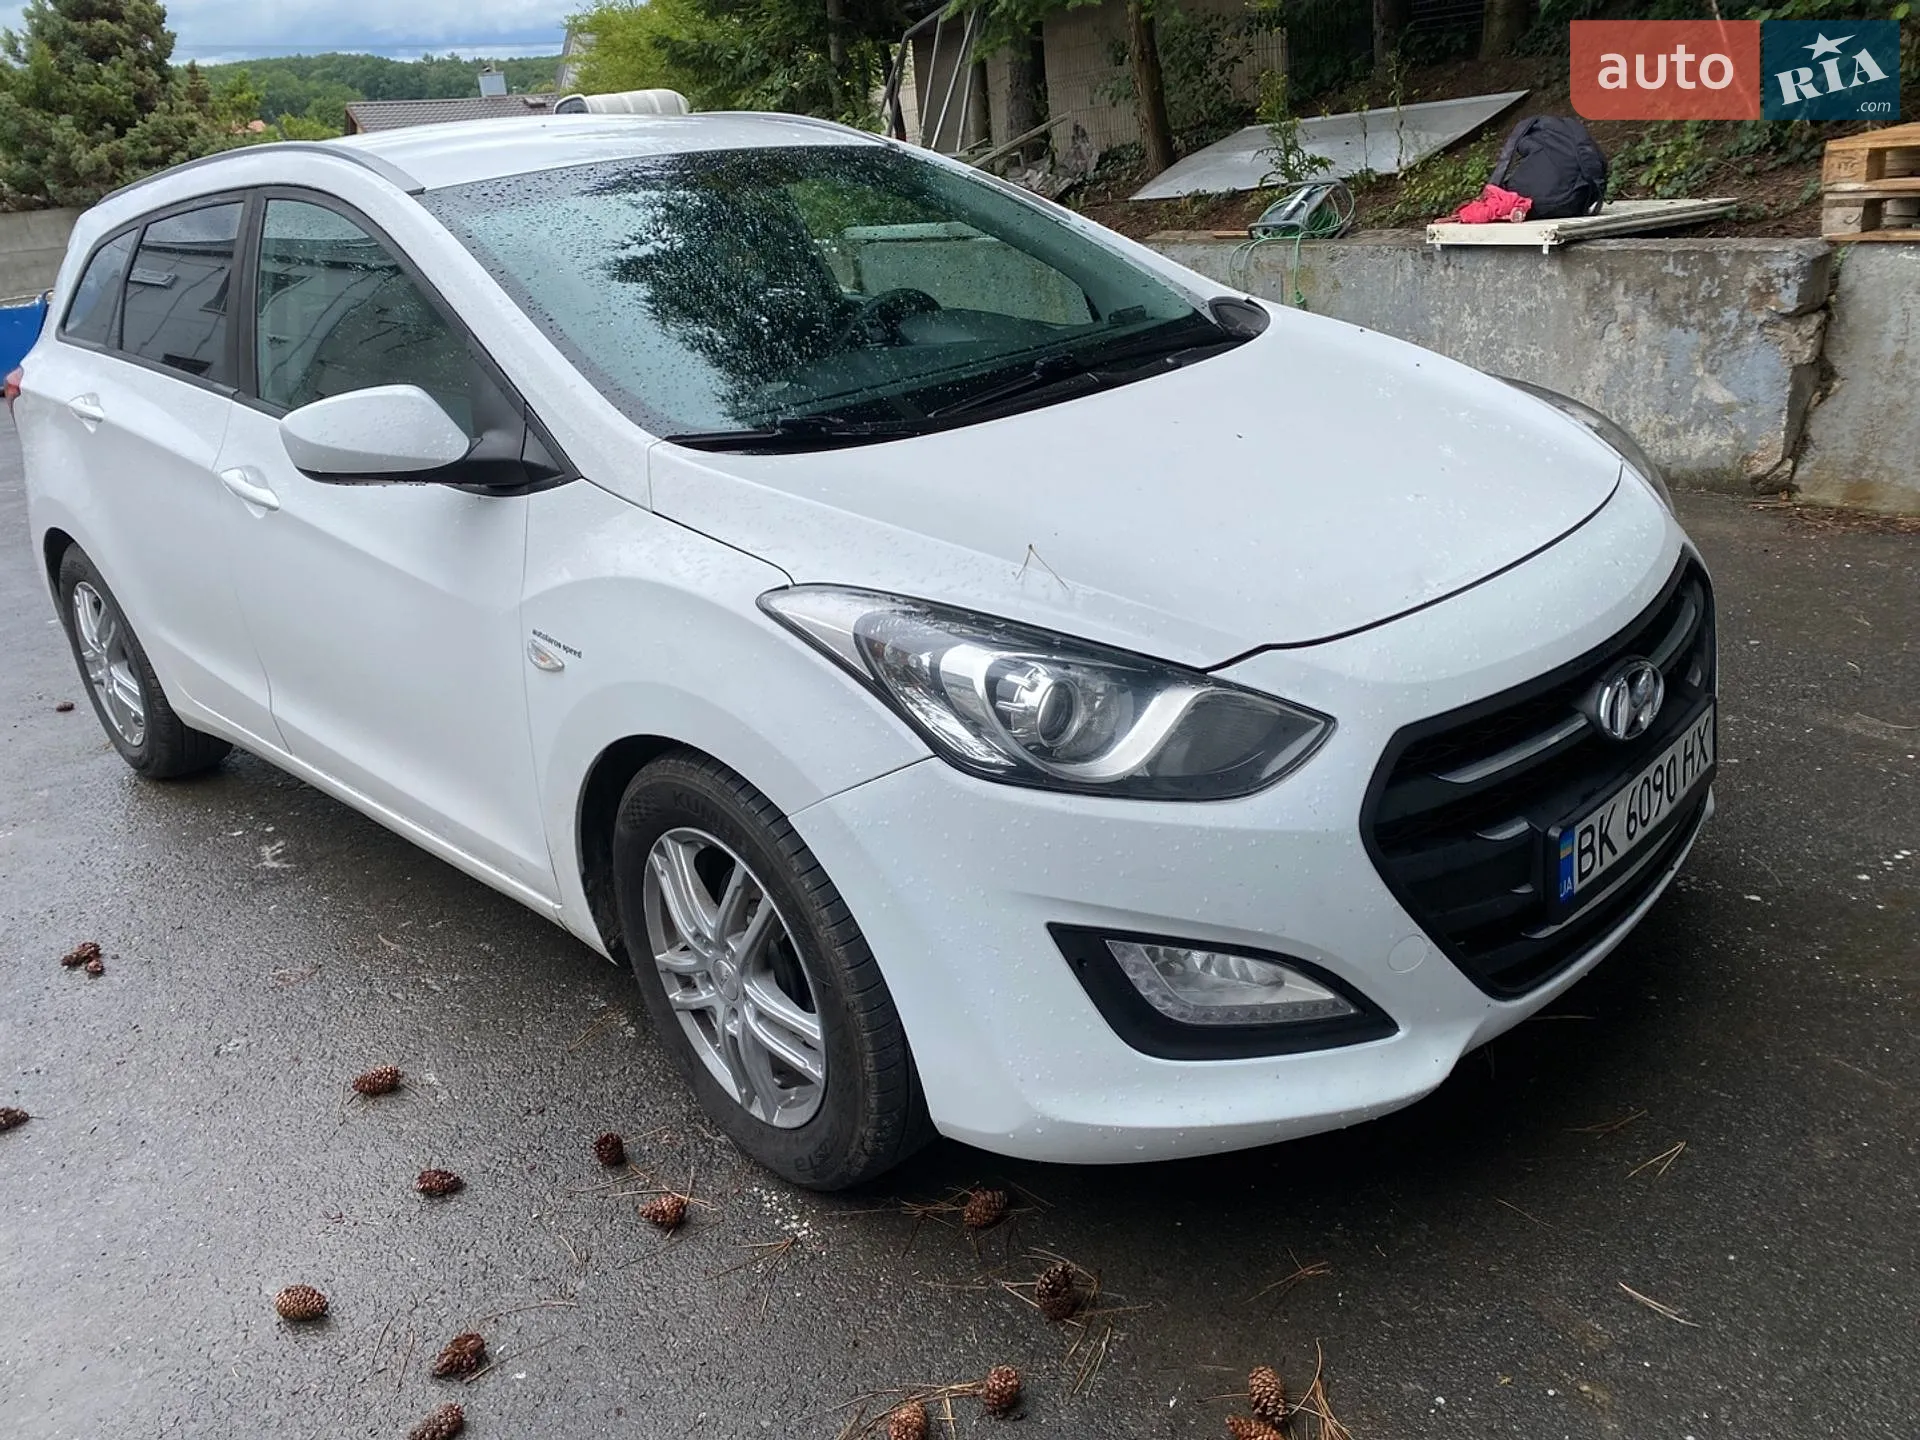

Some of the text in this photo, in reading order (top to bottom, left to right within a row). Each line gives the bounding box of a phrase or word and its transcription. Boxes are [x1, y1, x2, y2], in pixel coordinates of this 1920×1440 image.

[1578, 716, 1710, 884] BK 6090 HX
[1560, 876, 1573, 898] UA
